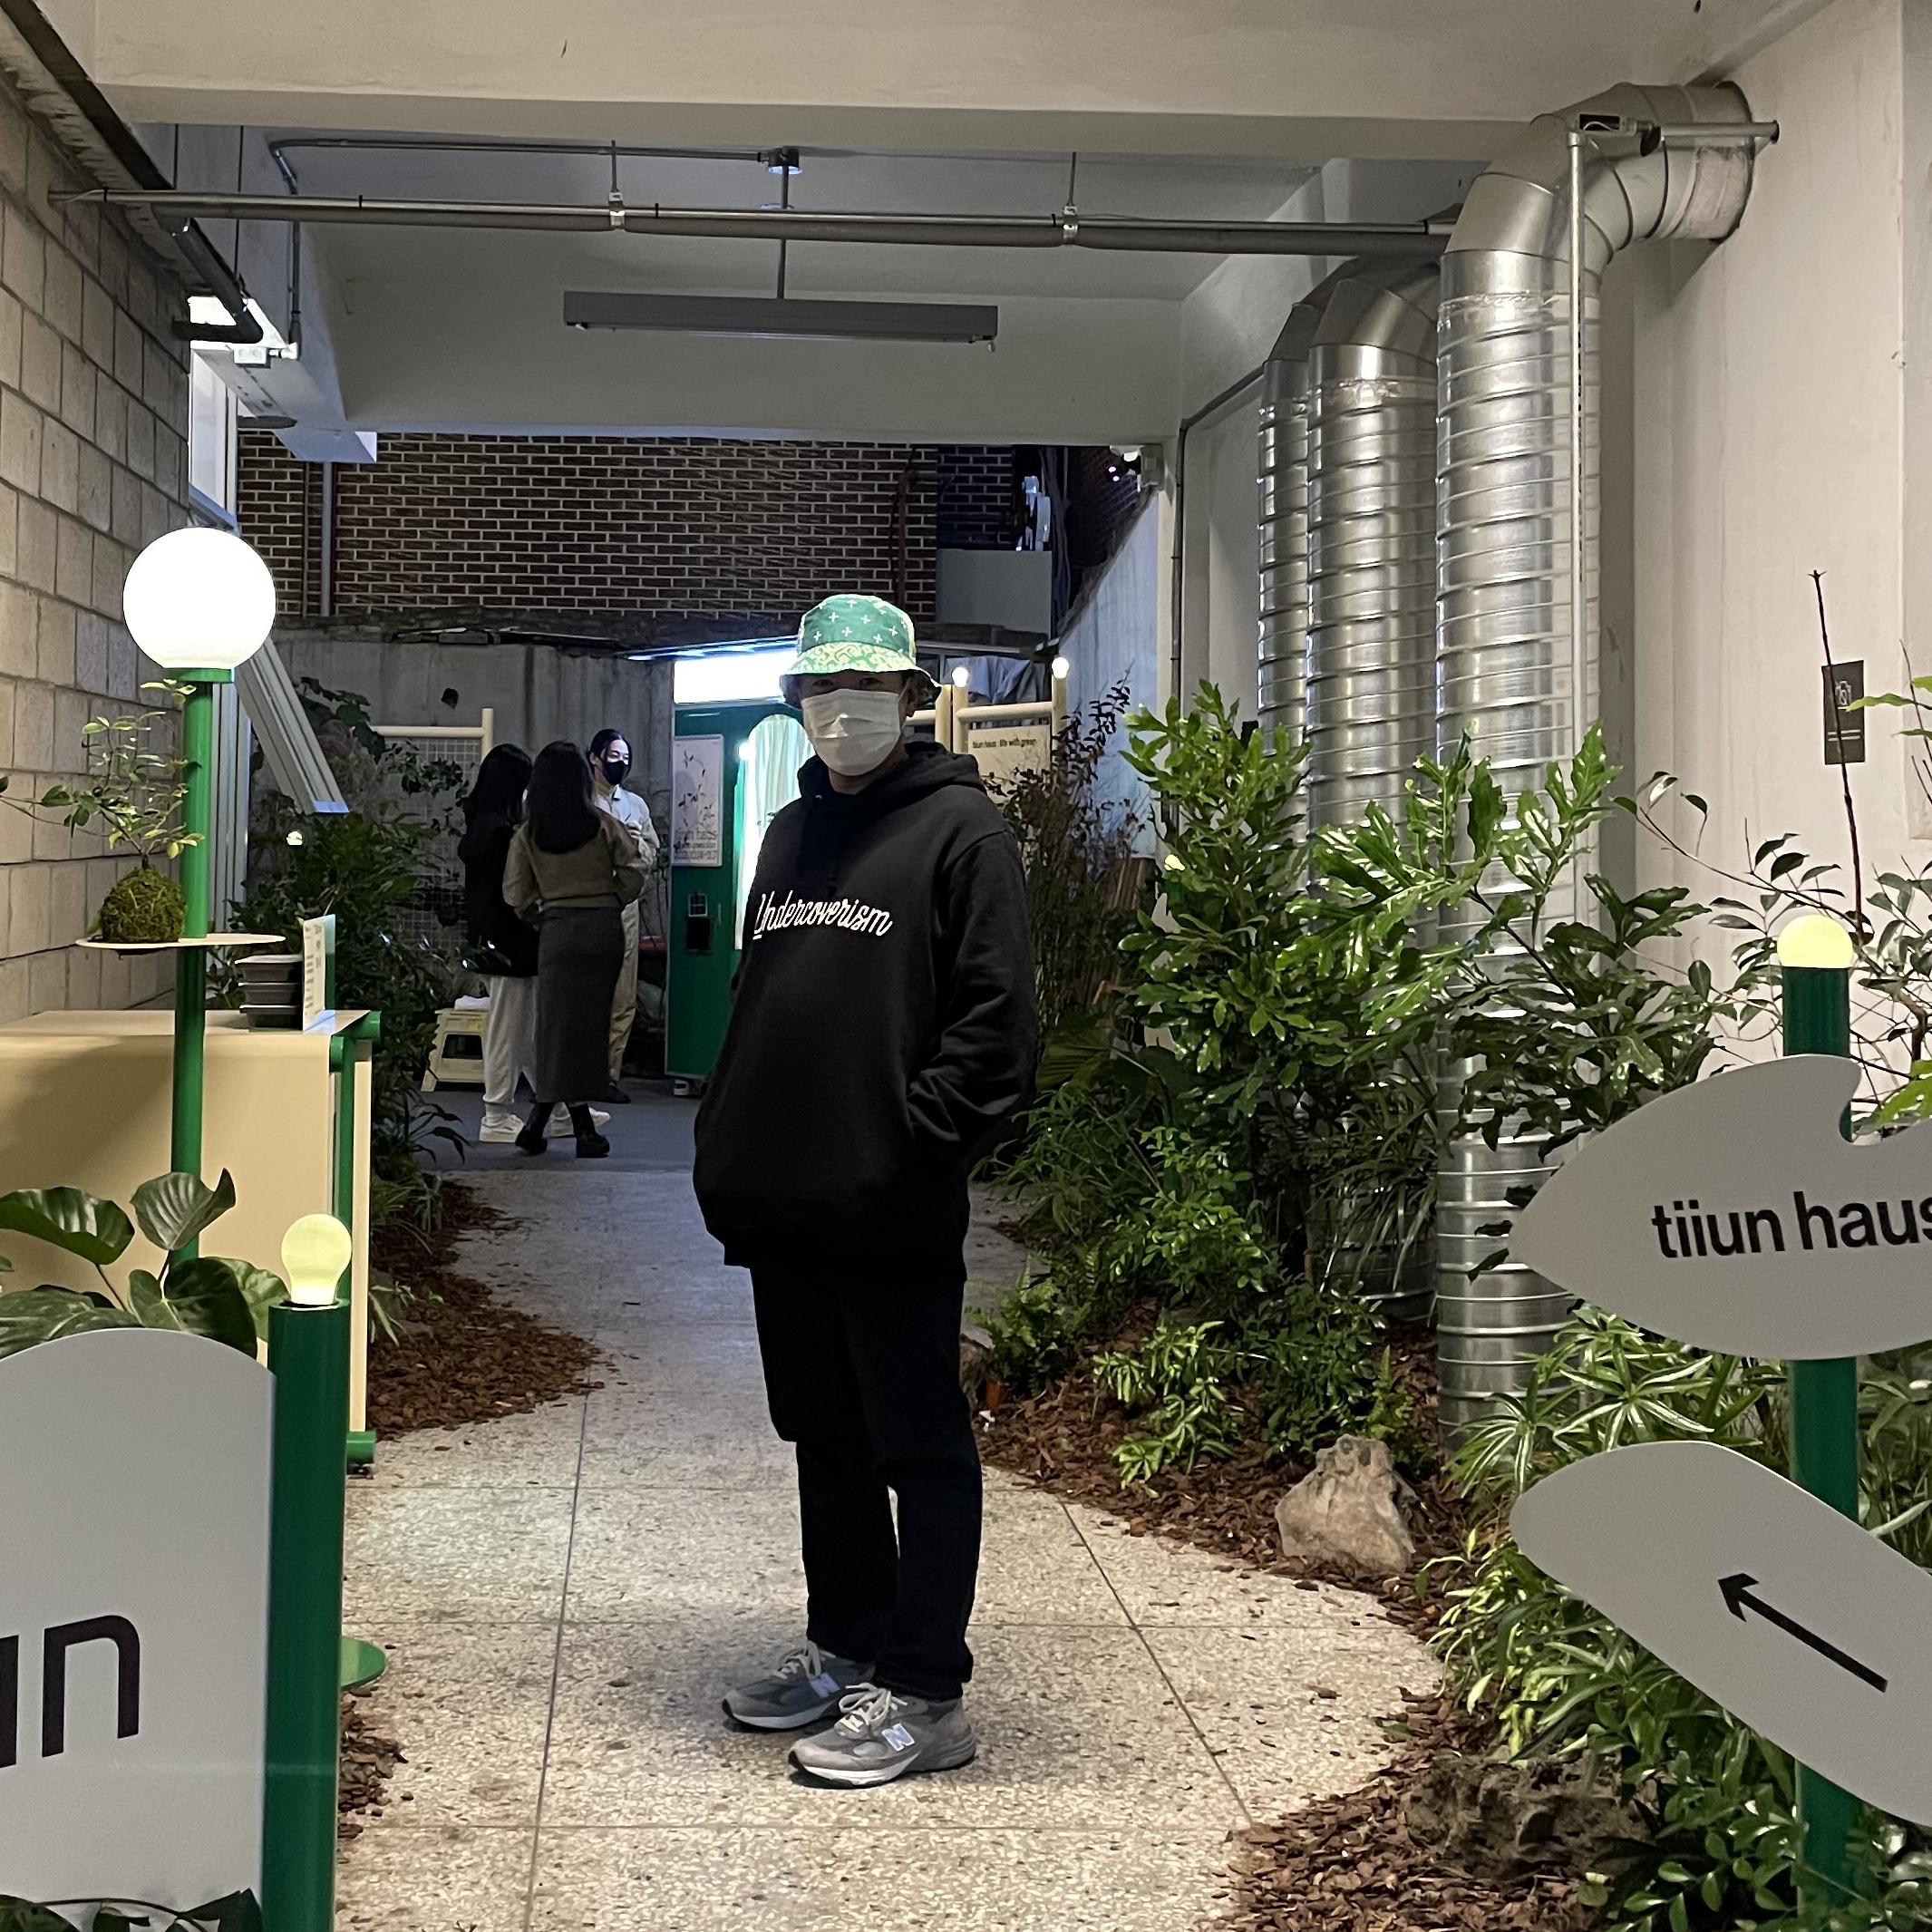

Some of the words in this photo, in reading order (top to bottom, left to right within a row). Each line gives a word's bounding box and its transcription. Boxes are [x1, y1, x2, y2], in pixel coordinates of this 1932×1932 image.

[752, 889, 894, 940] Undercoverism
[1651, 1199, 1785, 1258] tiiun
[0, 1615, 140, 1768] n
[881, 1723, 915, 1751] N
